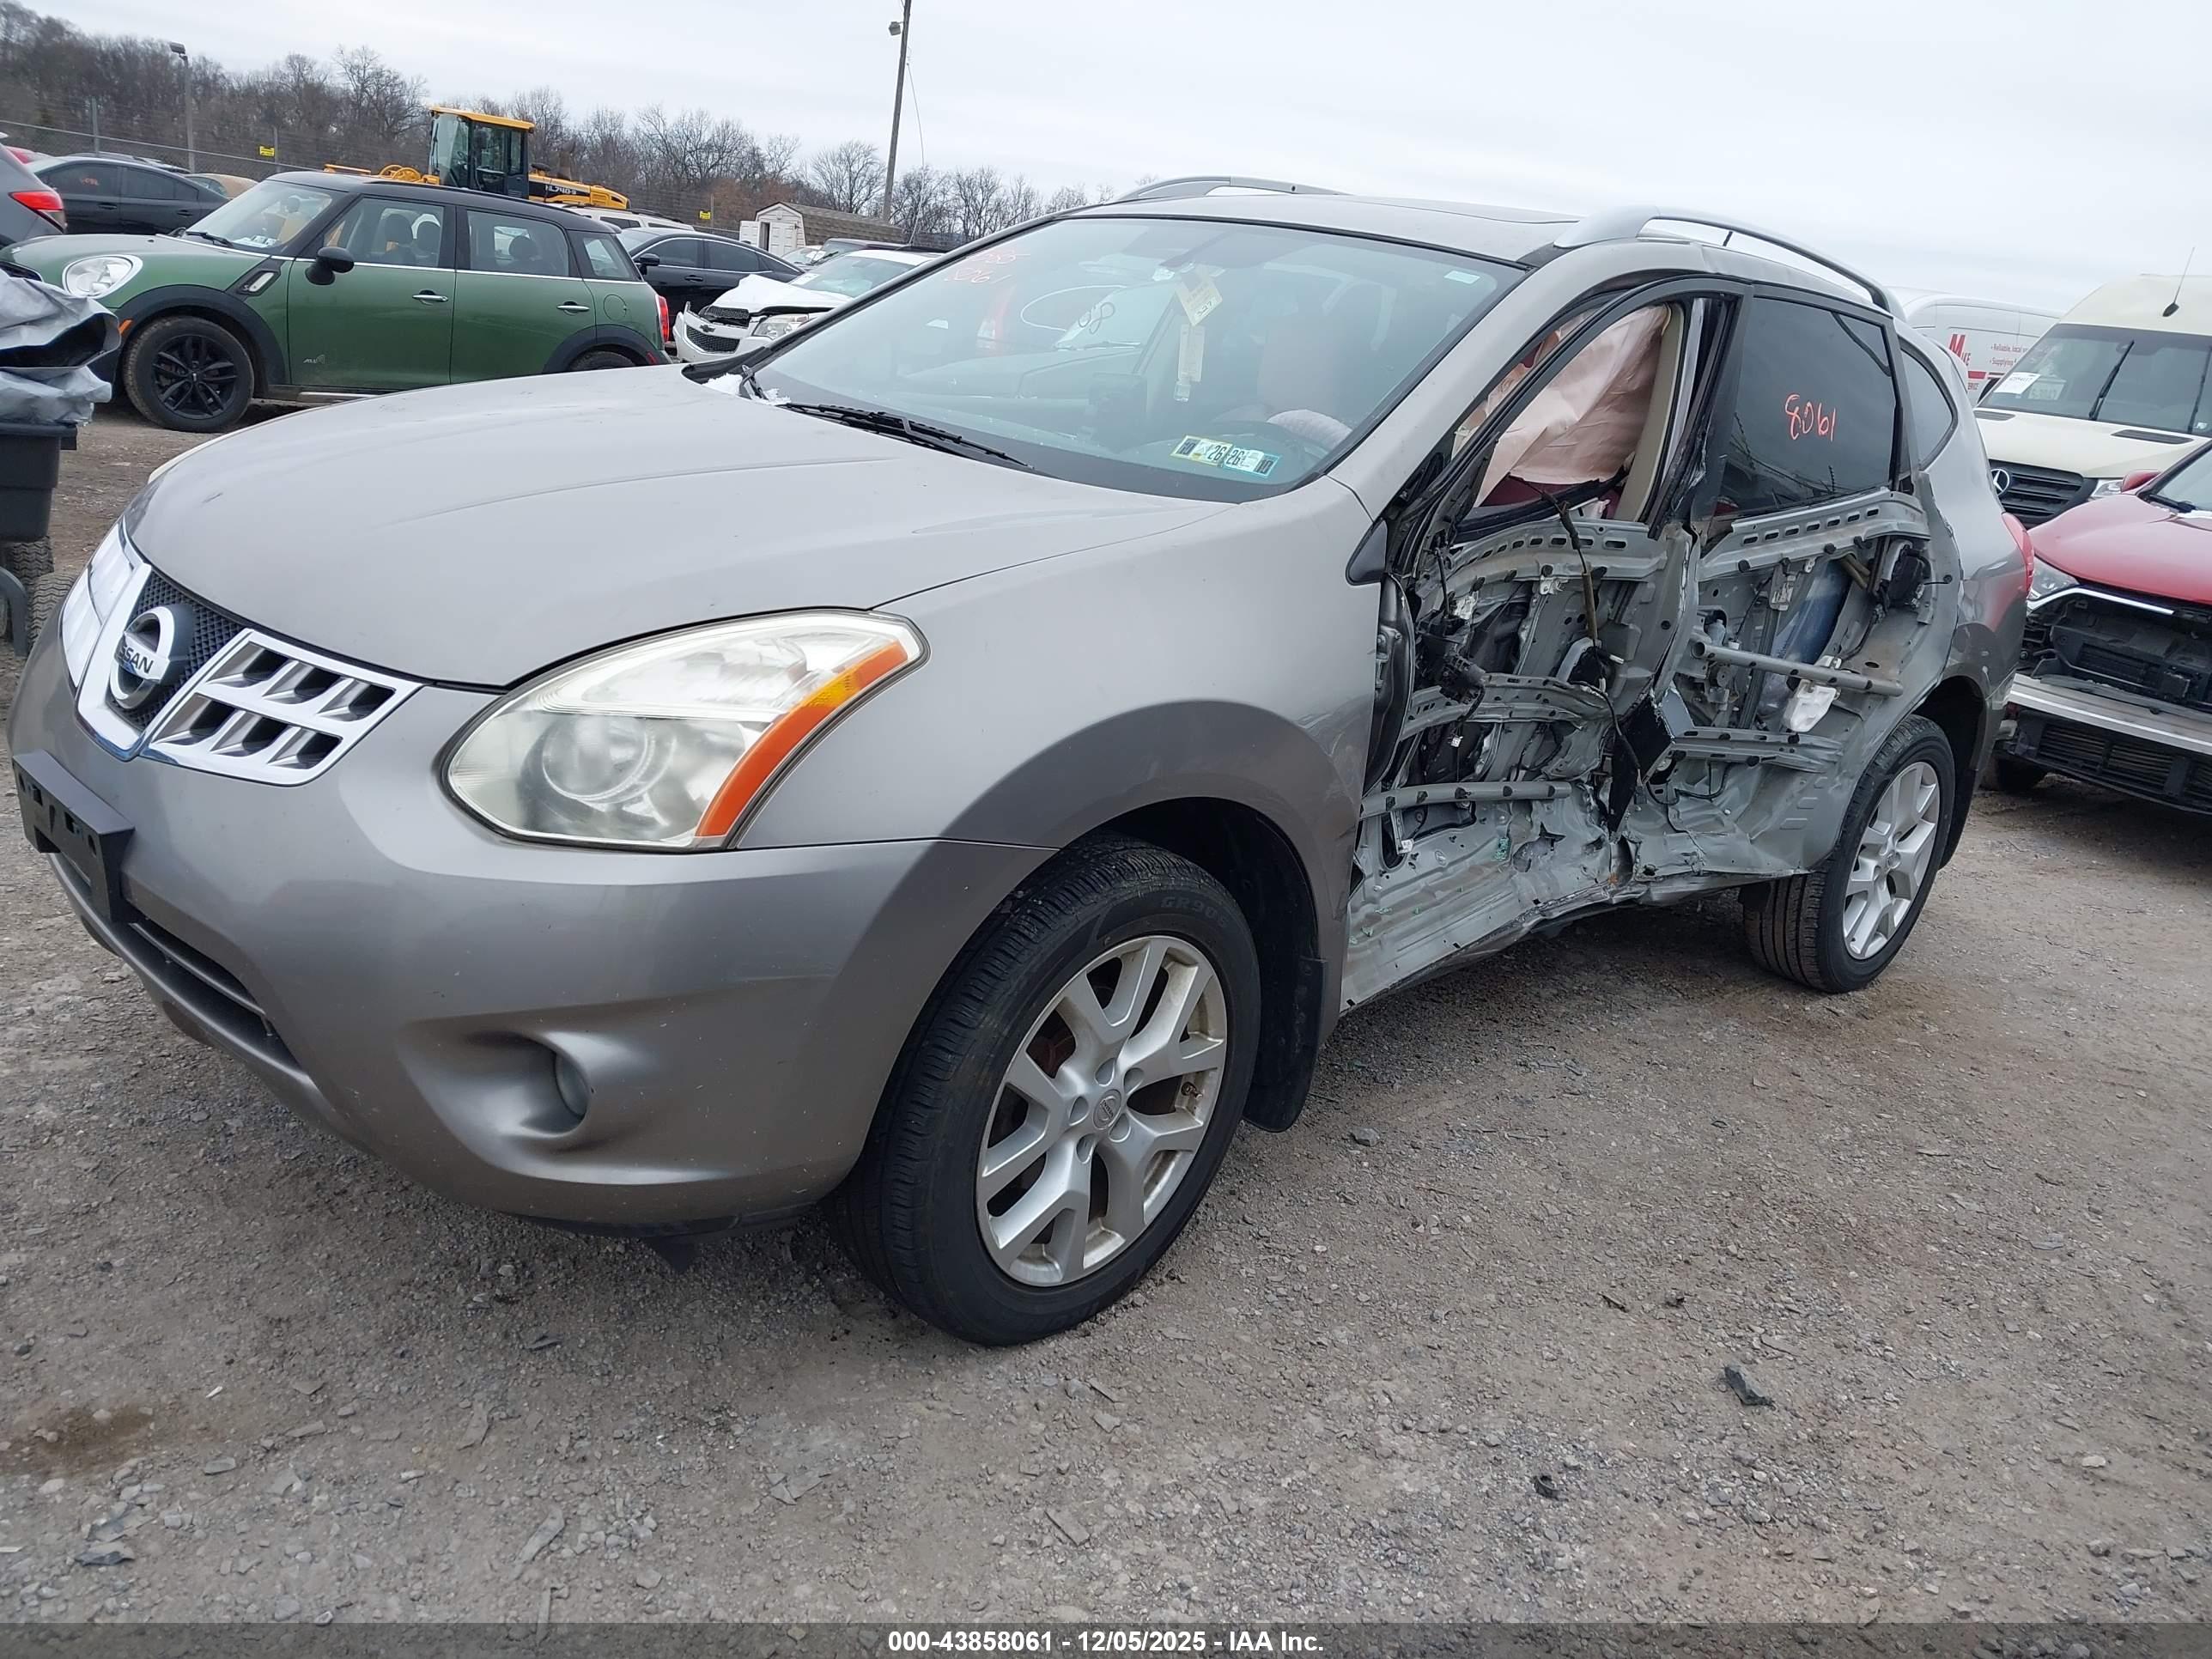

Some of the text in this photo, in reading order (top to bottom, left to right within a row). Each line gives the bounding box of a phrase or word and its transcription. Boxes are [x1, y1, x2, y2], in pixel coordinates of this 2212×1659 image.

[1784, 393, 1836, 442] 8061
[1207, 445, 1227, 461] 26
[1226, 449, 1245, 465] 26
